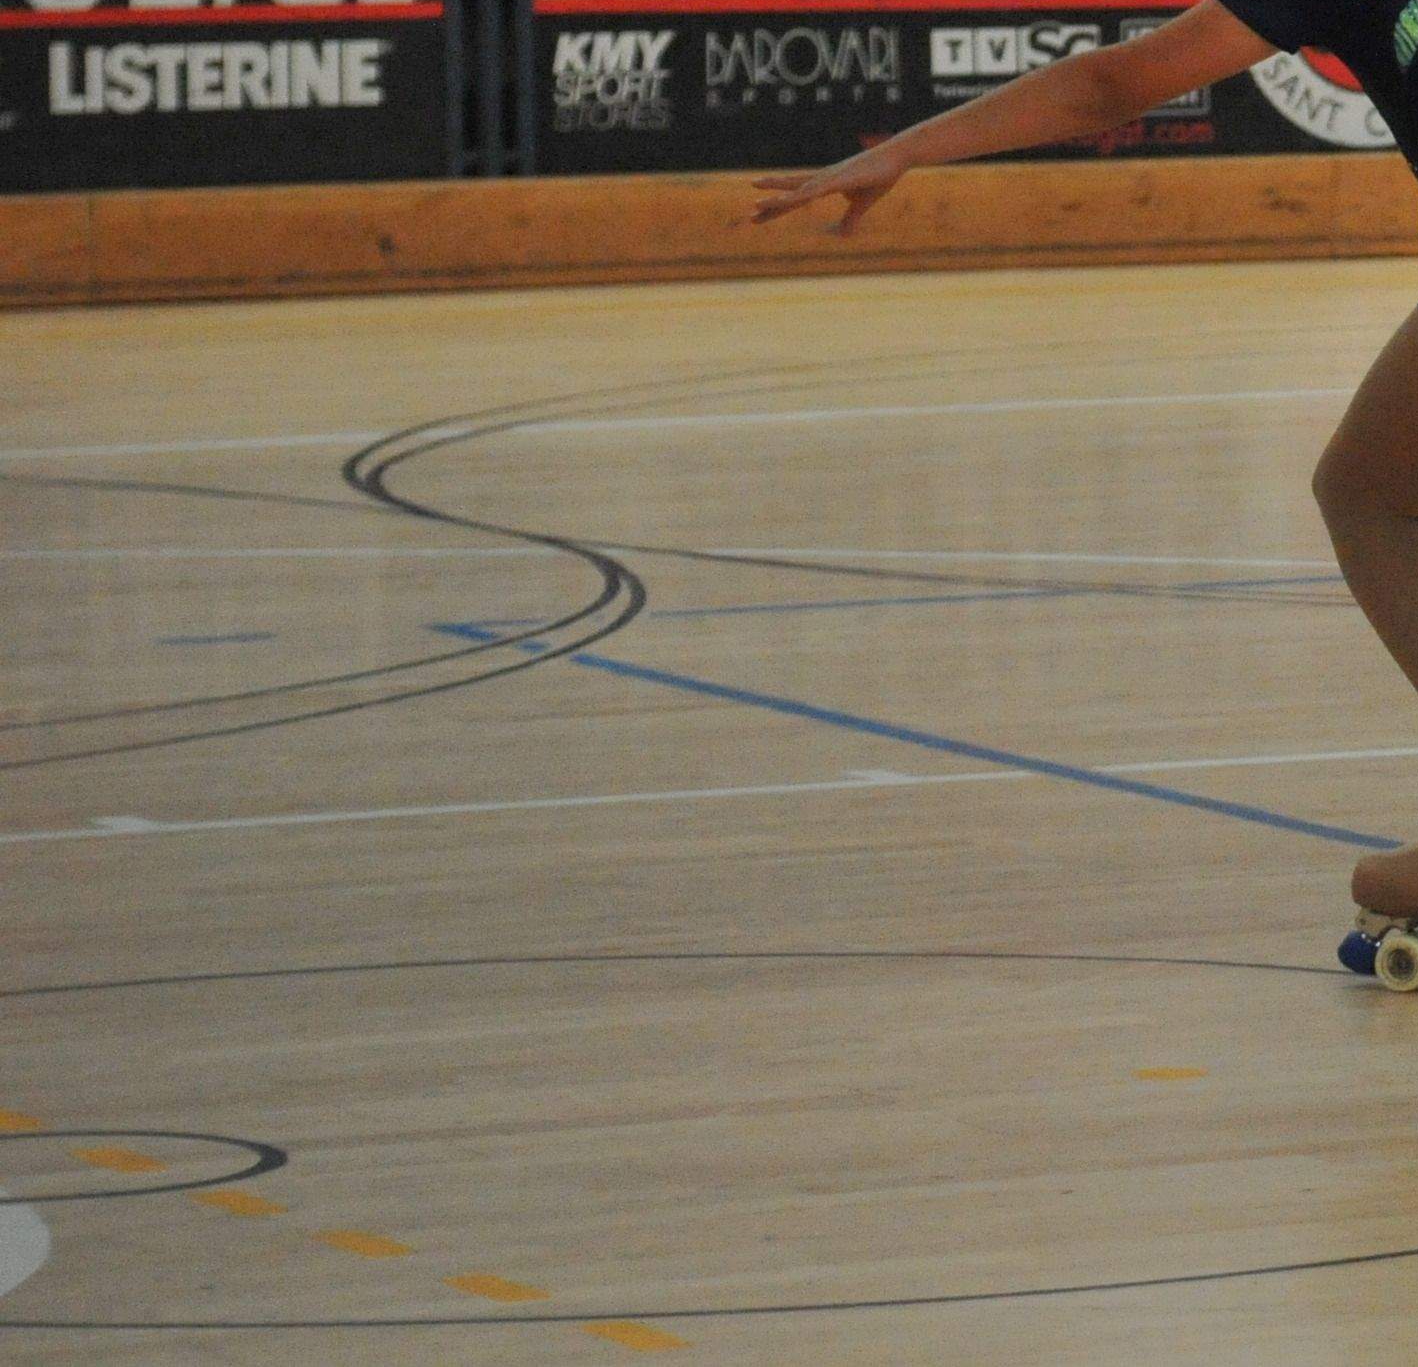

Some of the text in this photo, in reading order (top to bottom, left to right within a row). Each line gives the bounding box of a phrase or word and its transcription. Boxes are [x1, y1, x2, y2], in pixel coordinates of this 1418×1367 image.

[554, 29, 677, 73] KMY
[49, 38, 384, 115] LISTERINE
[554, 69, 672, 106] SPORT
